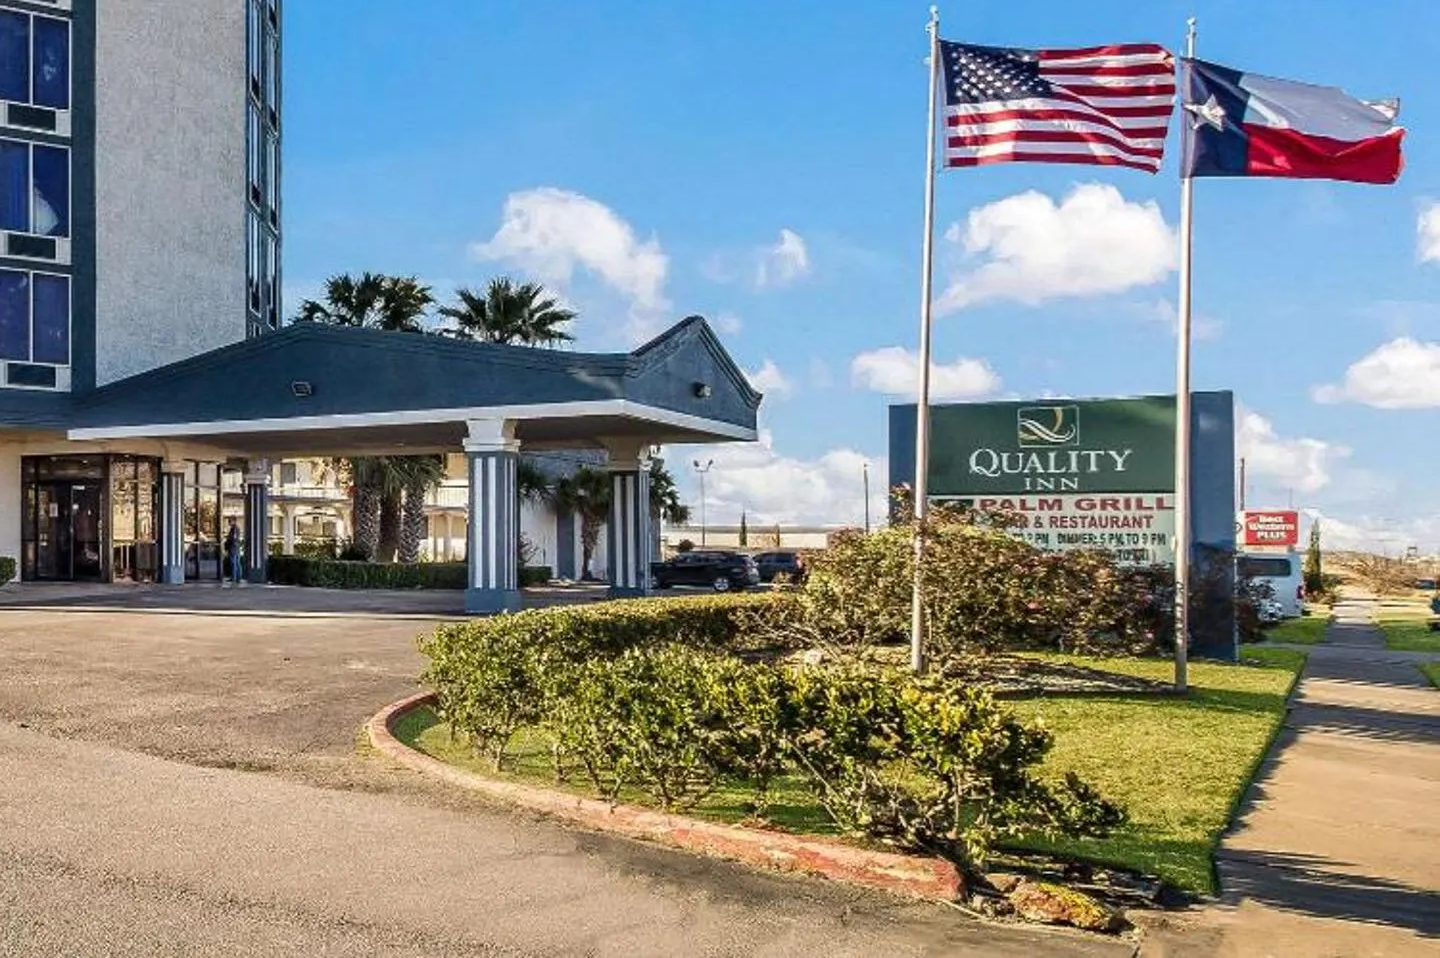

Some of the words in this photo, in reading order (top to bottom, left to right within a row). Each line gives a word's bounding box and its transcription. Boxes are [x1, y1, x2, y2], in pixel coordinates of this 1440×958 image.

[969, 448, 1132, 477] QUALITY
[1025, 477, 1078, 490] INN
[979, 498, 1063, 511] PALM
[1074, 496, 1175, 511] GRILL
[1034, 514, 1043, 528] &
[1049, 515, 1154, 529] RESTAURANT
